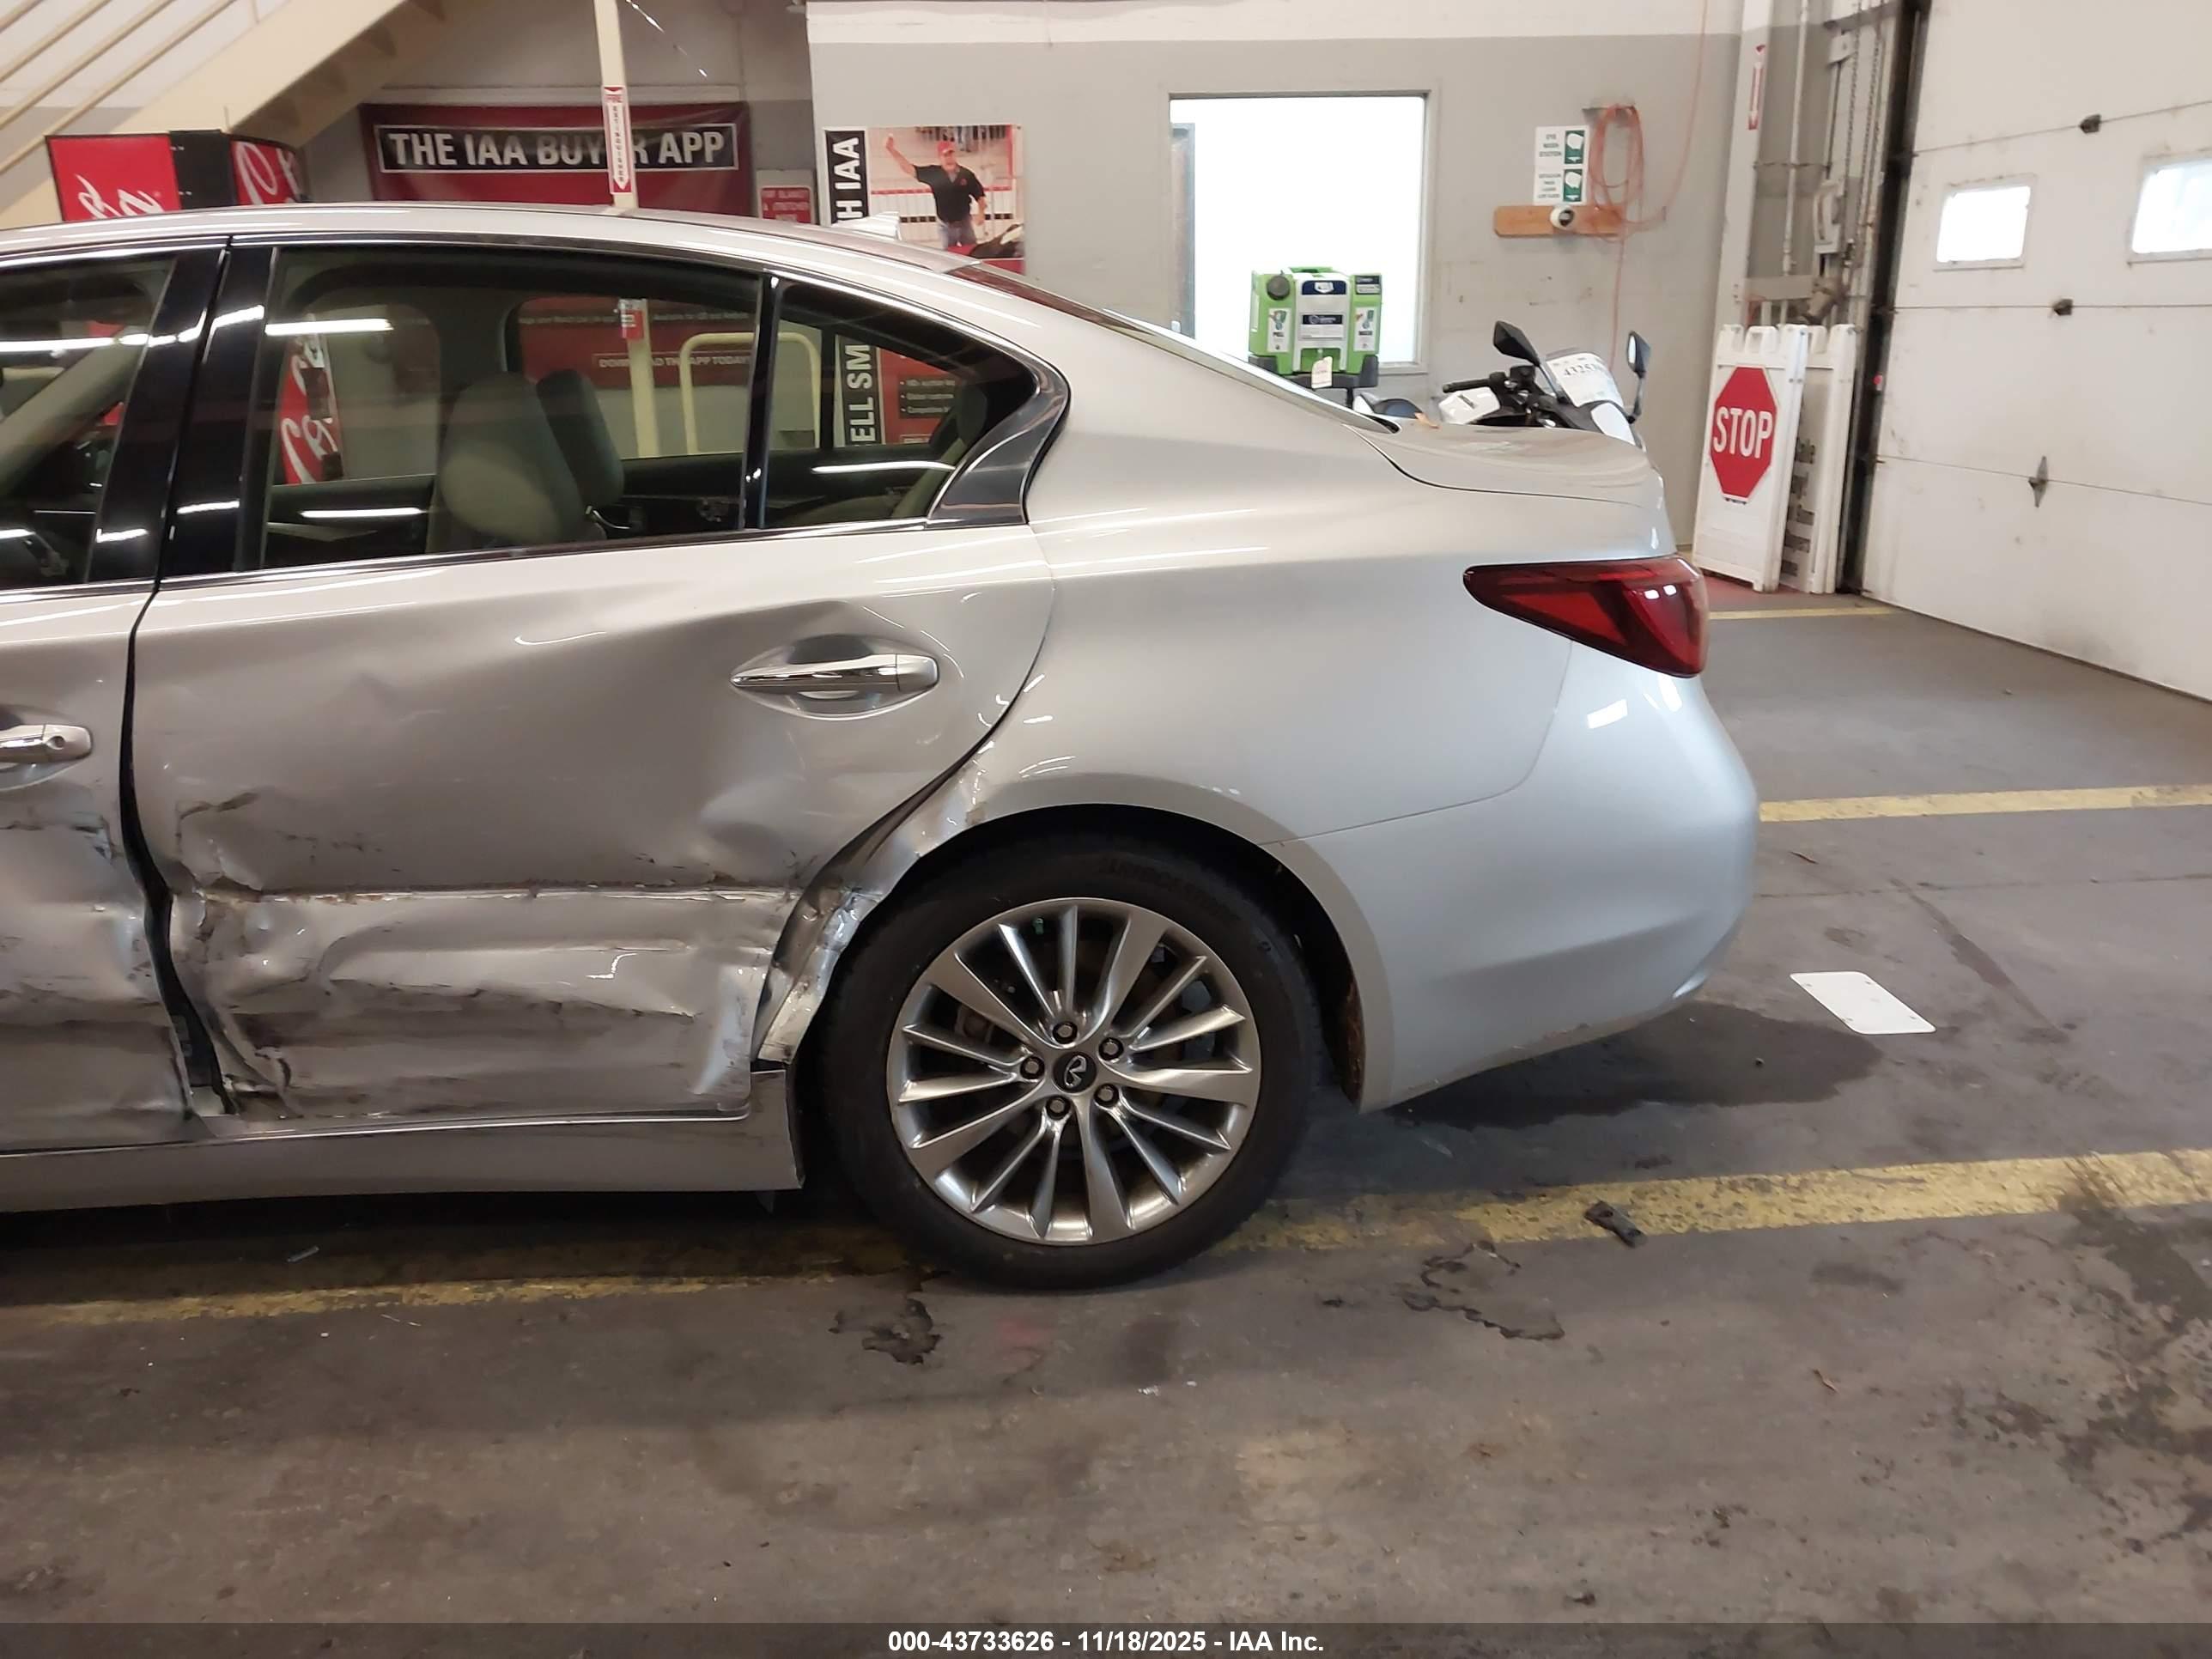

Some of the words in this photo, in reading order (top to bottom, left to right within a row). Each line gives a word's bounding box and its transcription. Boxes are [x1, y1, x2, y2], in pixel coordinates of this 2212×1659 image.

[389, 132, 458, 166] THE
[465, 134, 527, 166] IAA
[537, 134, 648, 166] BUYR
[659, 131, 724, 163] APP
[832, 137, 862, 190] IAA
[848, 396, 876, 444] ELL
[1713, 406, 1773, 459] STOP
